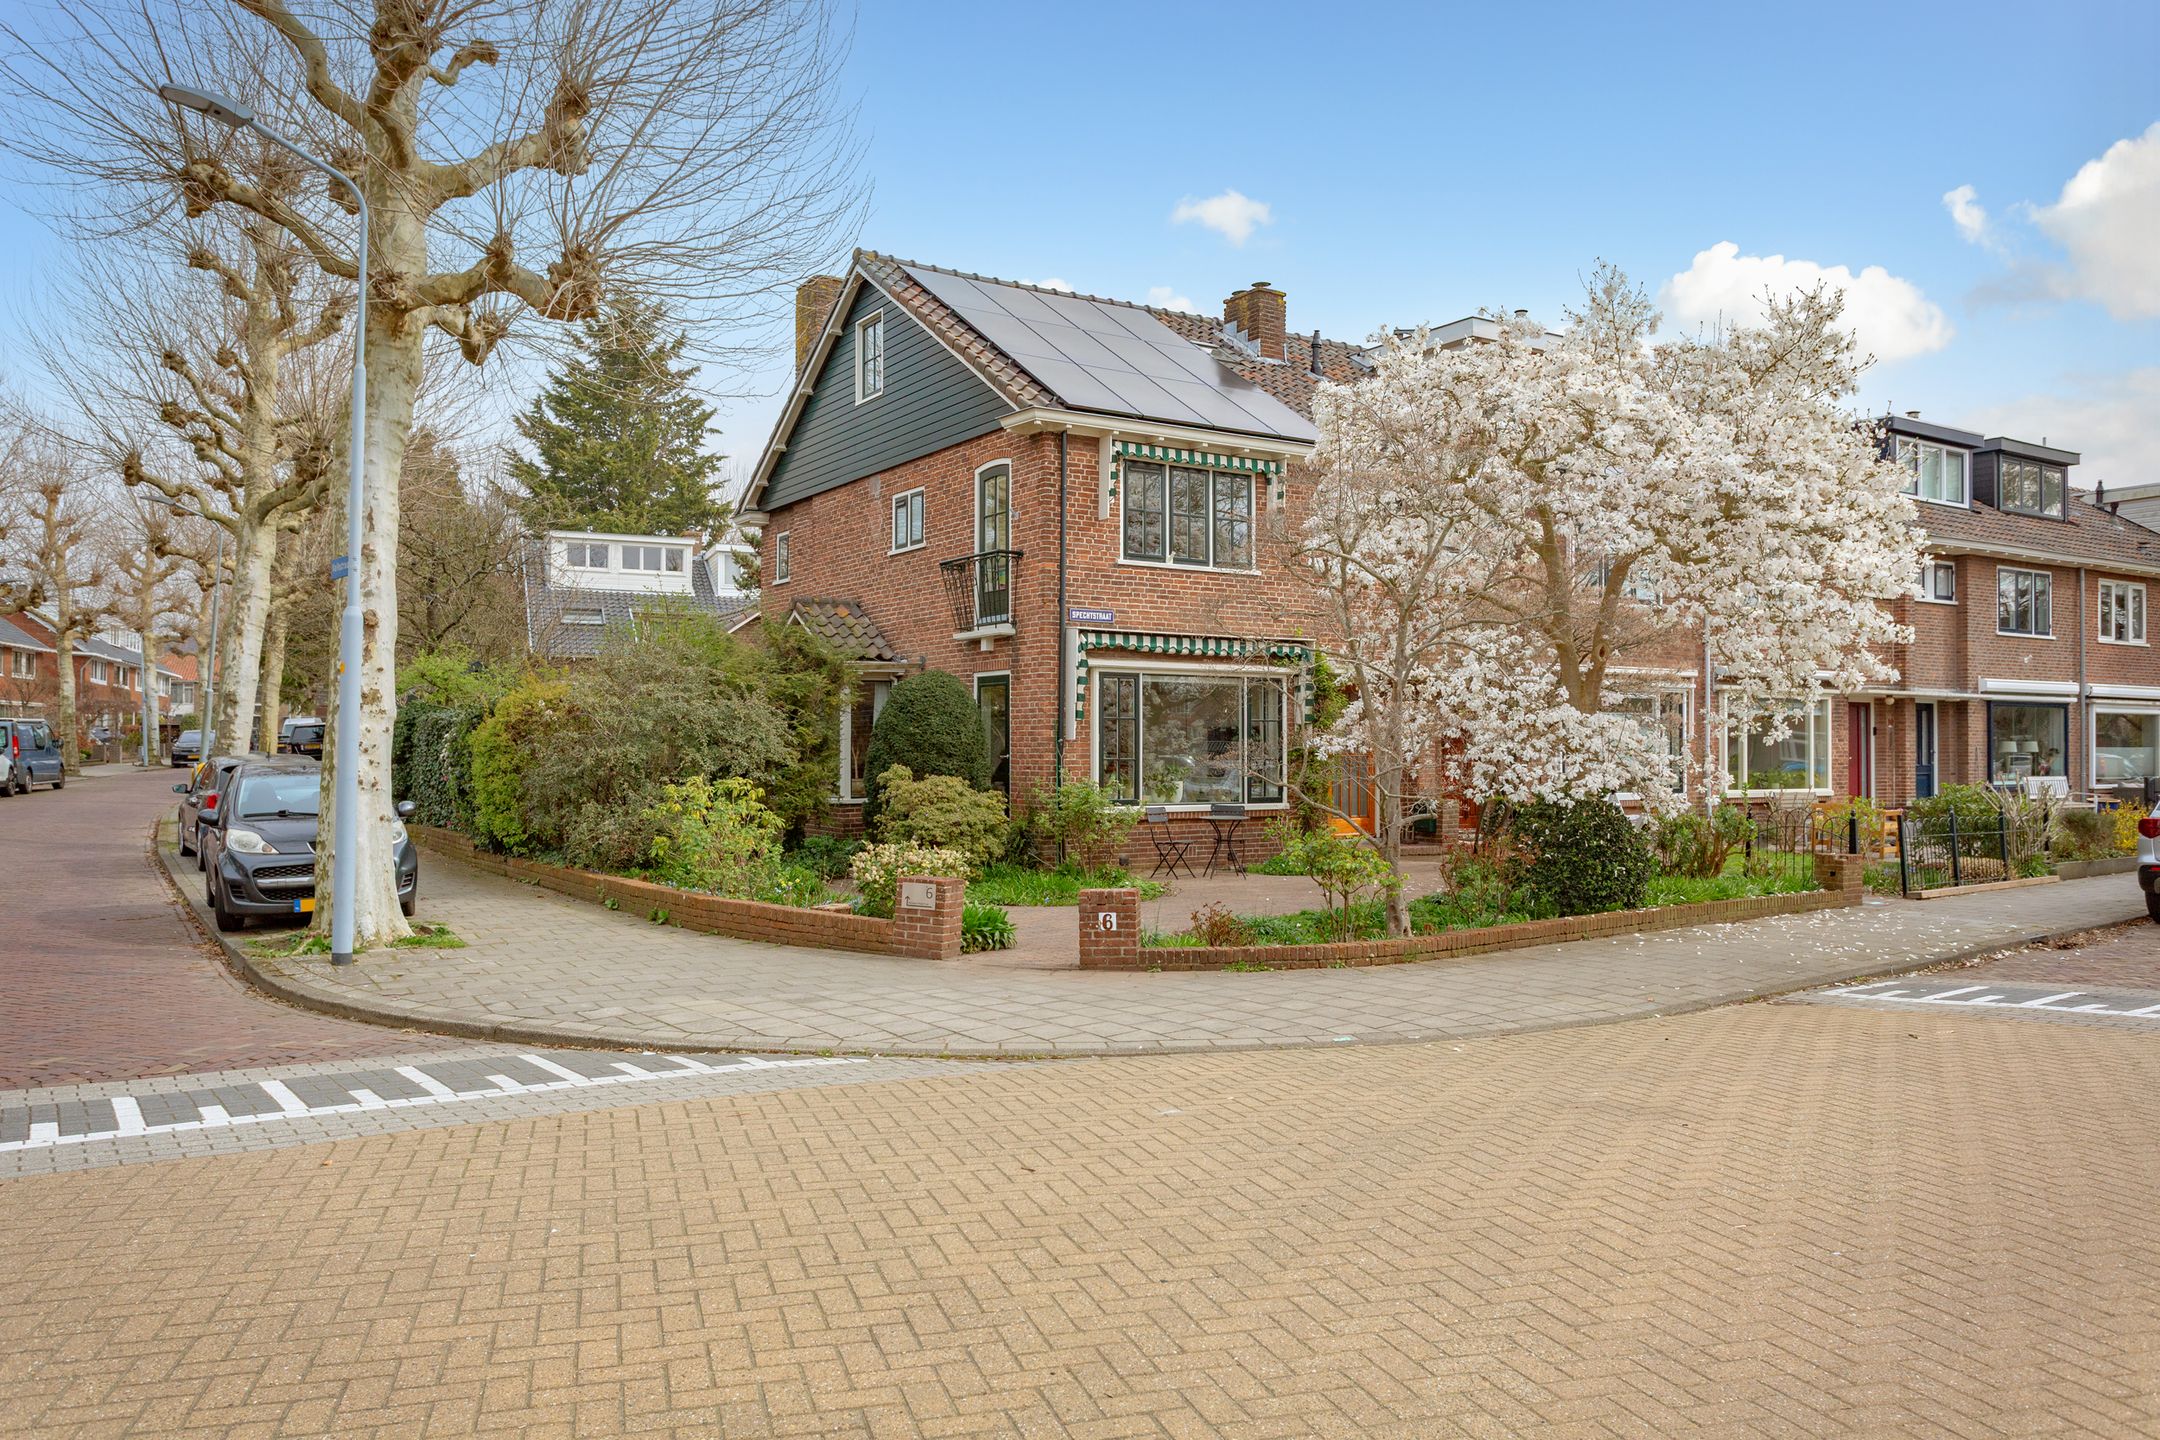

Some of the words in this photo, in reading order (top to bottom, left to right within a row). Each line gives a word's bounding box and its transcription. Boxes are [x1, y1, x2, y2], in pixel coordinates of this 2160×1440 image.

[1072, 611, 1112, 620] SPECHTSTRAAT
[926, 887, 933, 899] 6
[1102, 913, 1113, 930] 6
